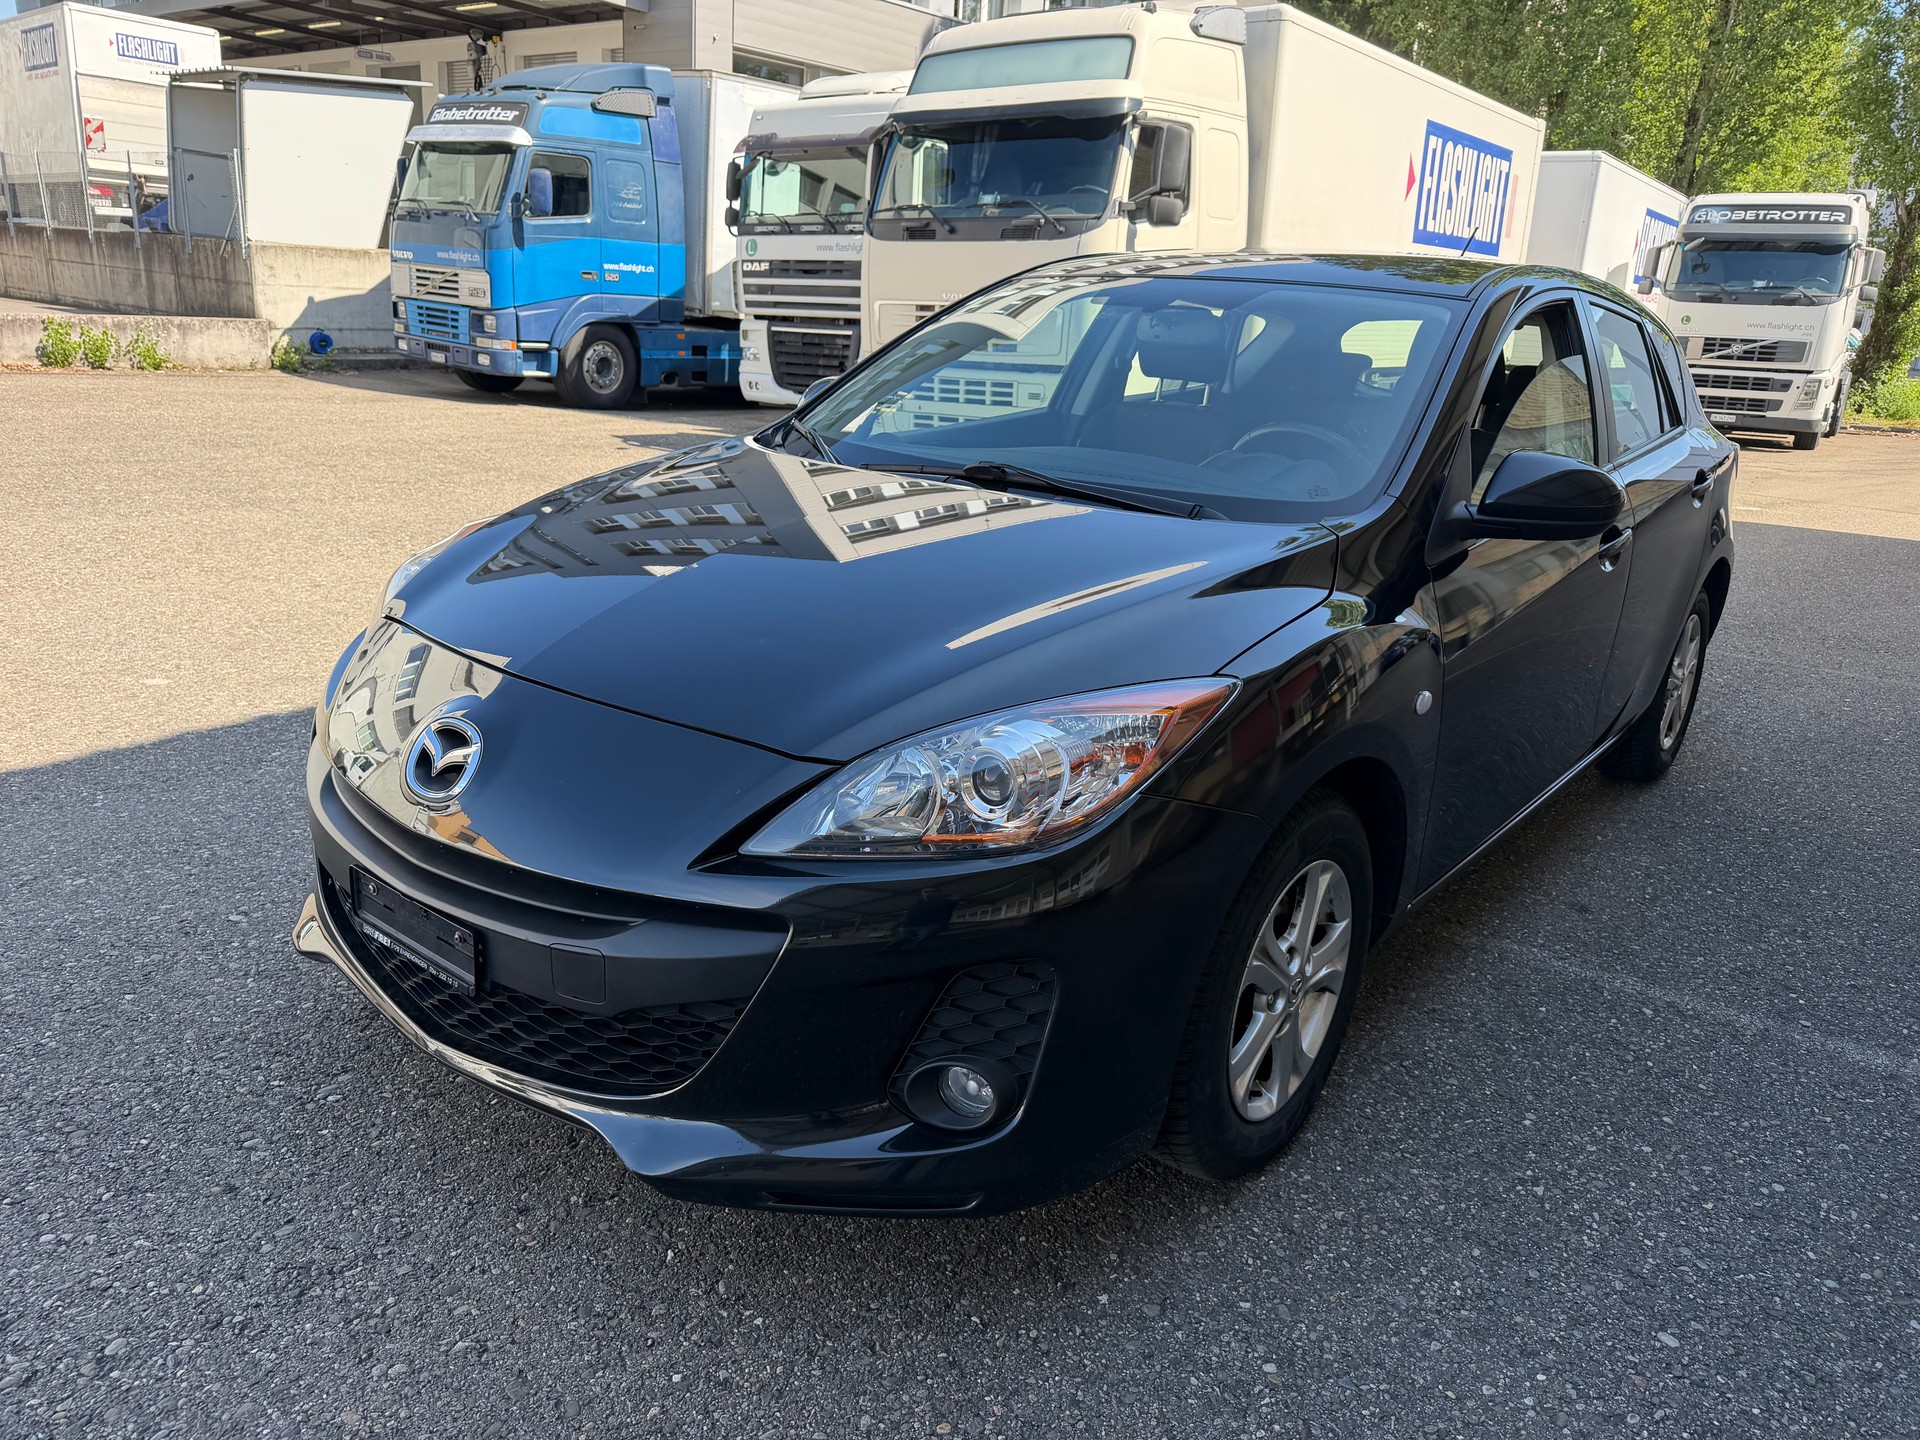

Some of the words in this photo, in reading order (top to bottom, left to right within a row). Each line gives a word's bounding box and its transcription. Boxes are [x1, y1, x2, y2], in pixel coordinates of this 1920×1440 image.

[117, 33, 176, 64] FLASHLIGHT
[429, 106, 520, 122] Globetrotter
[1418, 134, 1510, 244] FLASHLIGHT
[1695, 210, 1846, 222] GLOBETROTTER
[392, 249, 414, 260] VOLVO
[742, 262, 770, 271] DAF
[604, 273, 620, 282] 520
[1747, 321, 1815, 332] www.flashlight.ch
[374, 930, 390, 947] FREI
